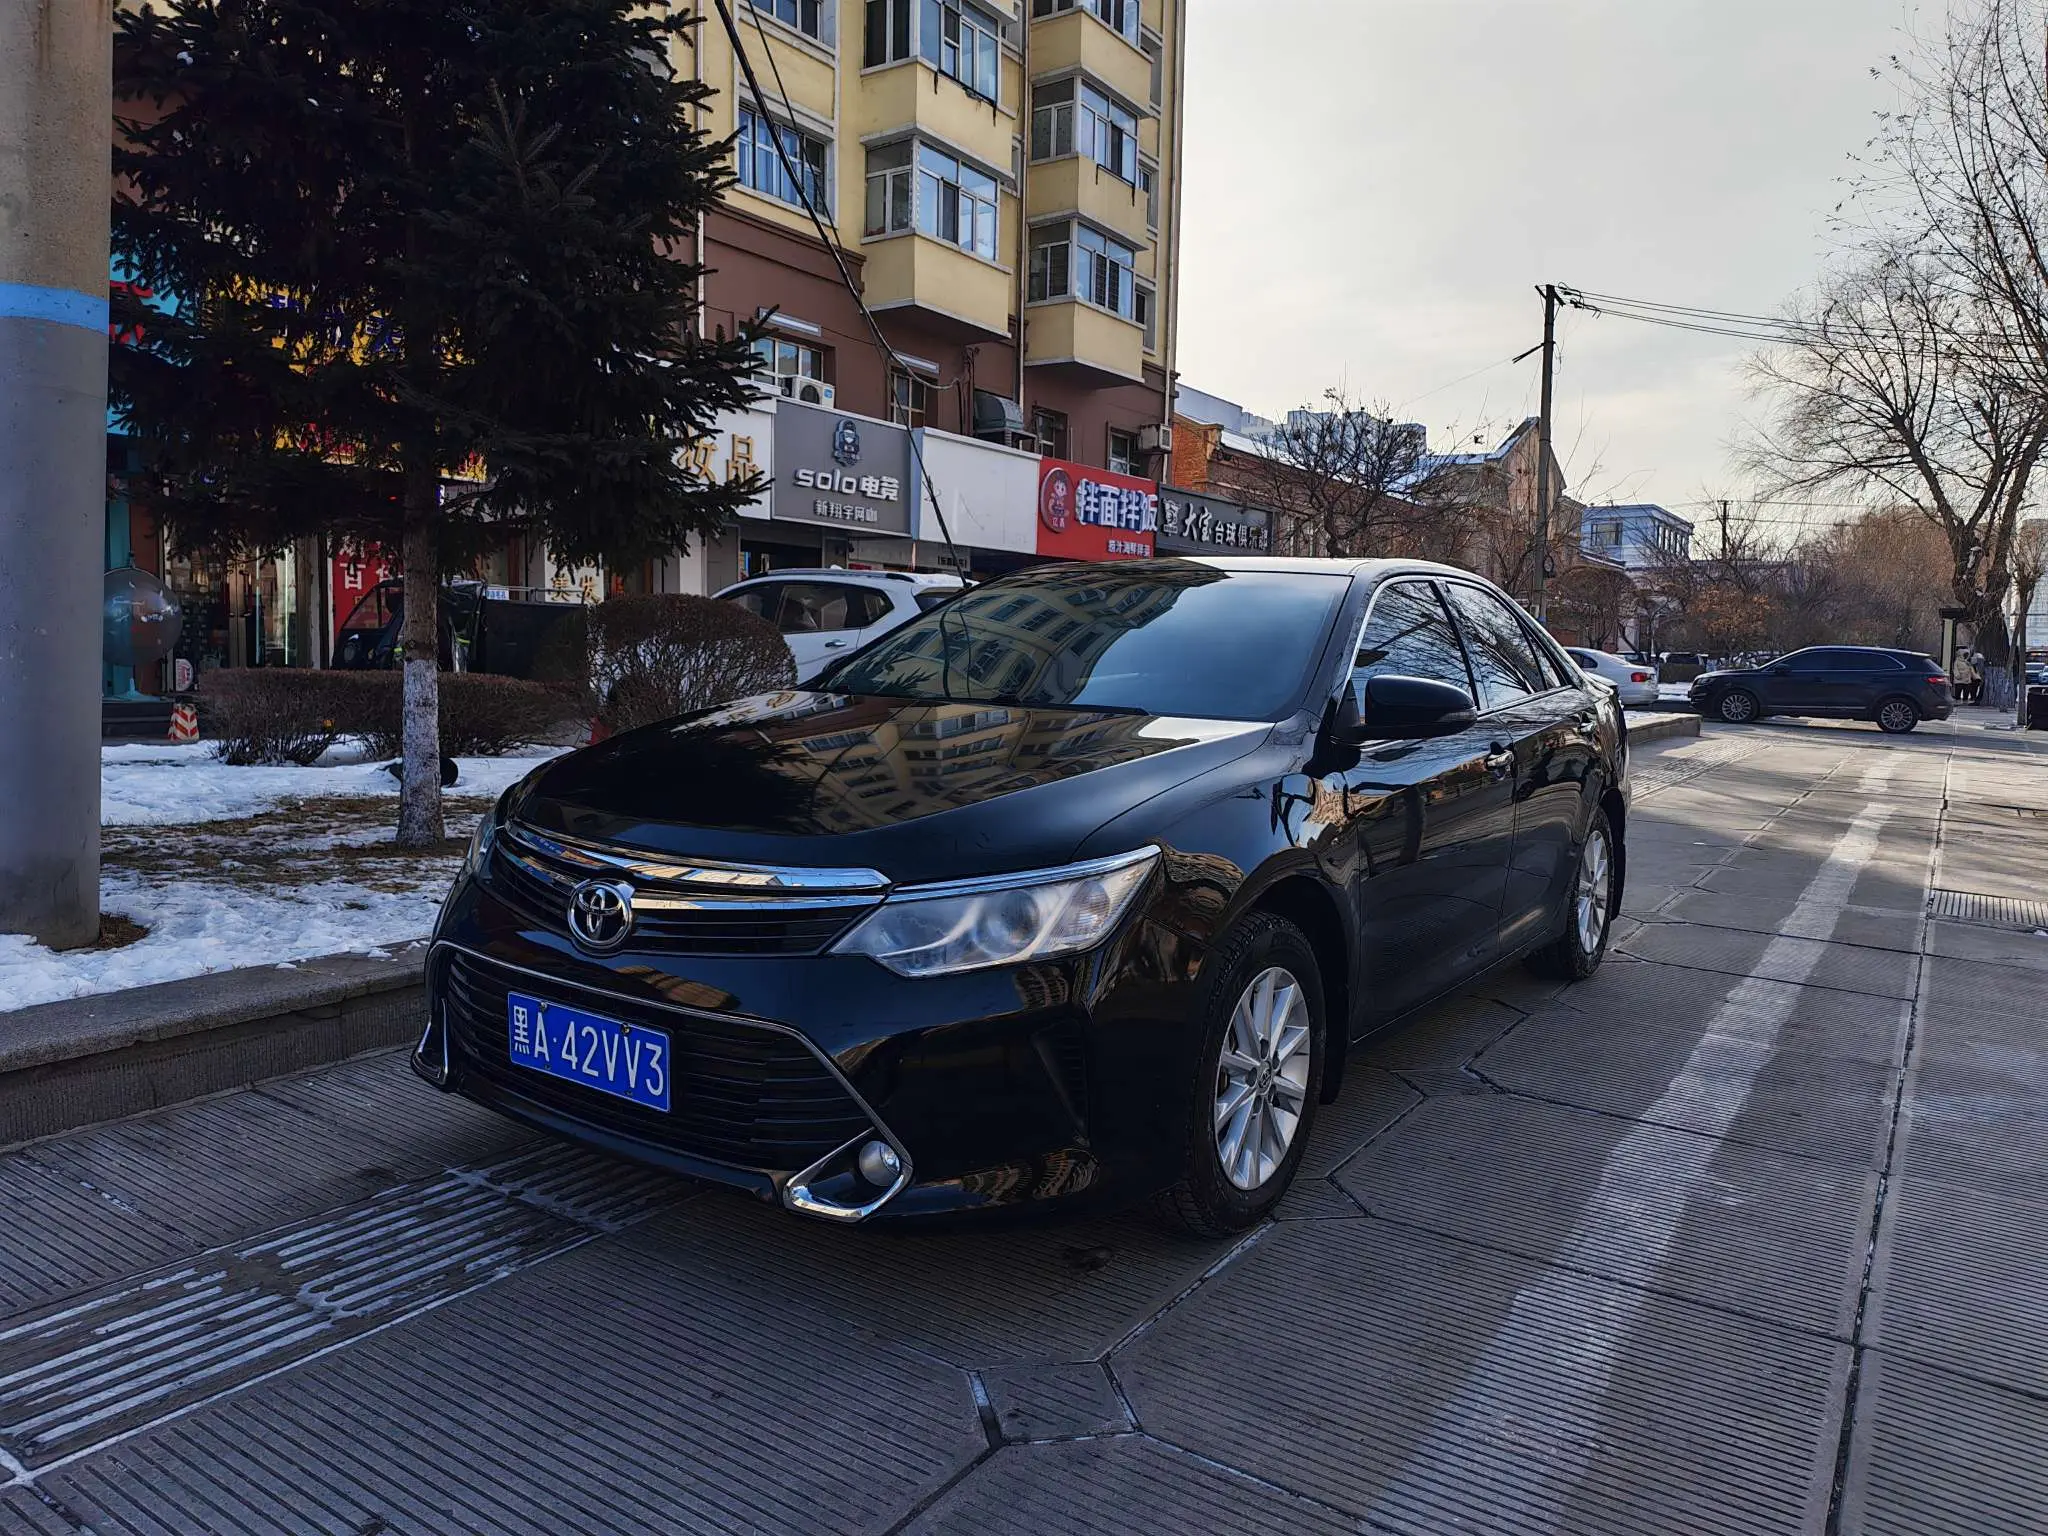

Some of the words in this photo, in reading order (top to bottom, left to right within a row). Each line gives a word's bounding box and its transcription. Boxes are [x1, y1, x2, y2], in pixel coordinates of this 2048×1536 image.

[815, 499, 878, 523] 新翔宇网咖
[1076, 478, 1158, 535] 拌面拌饭
